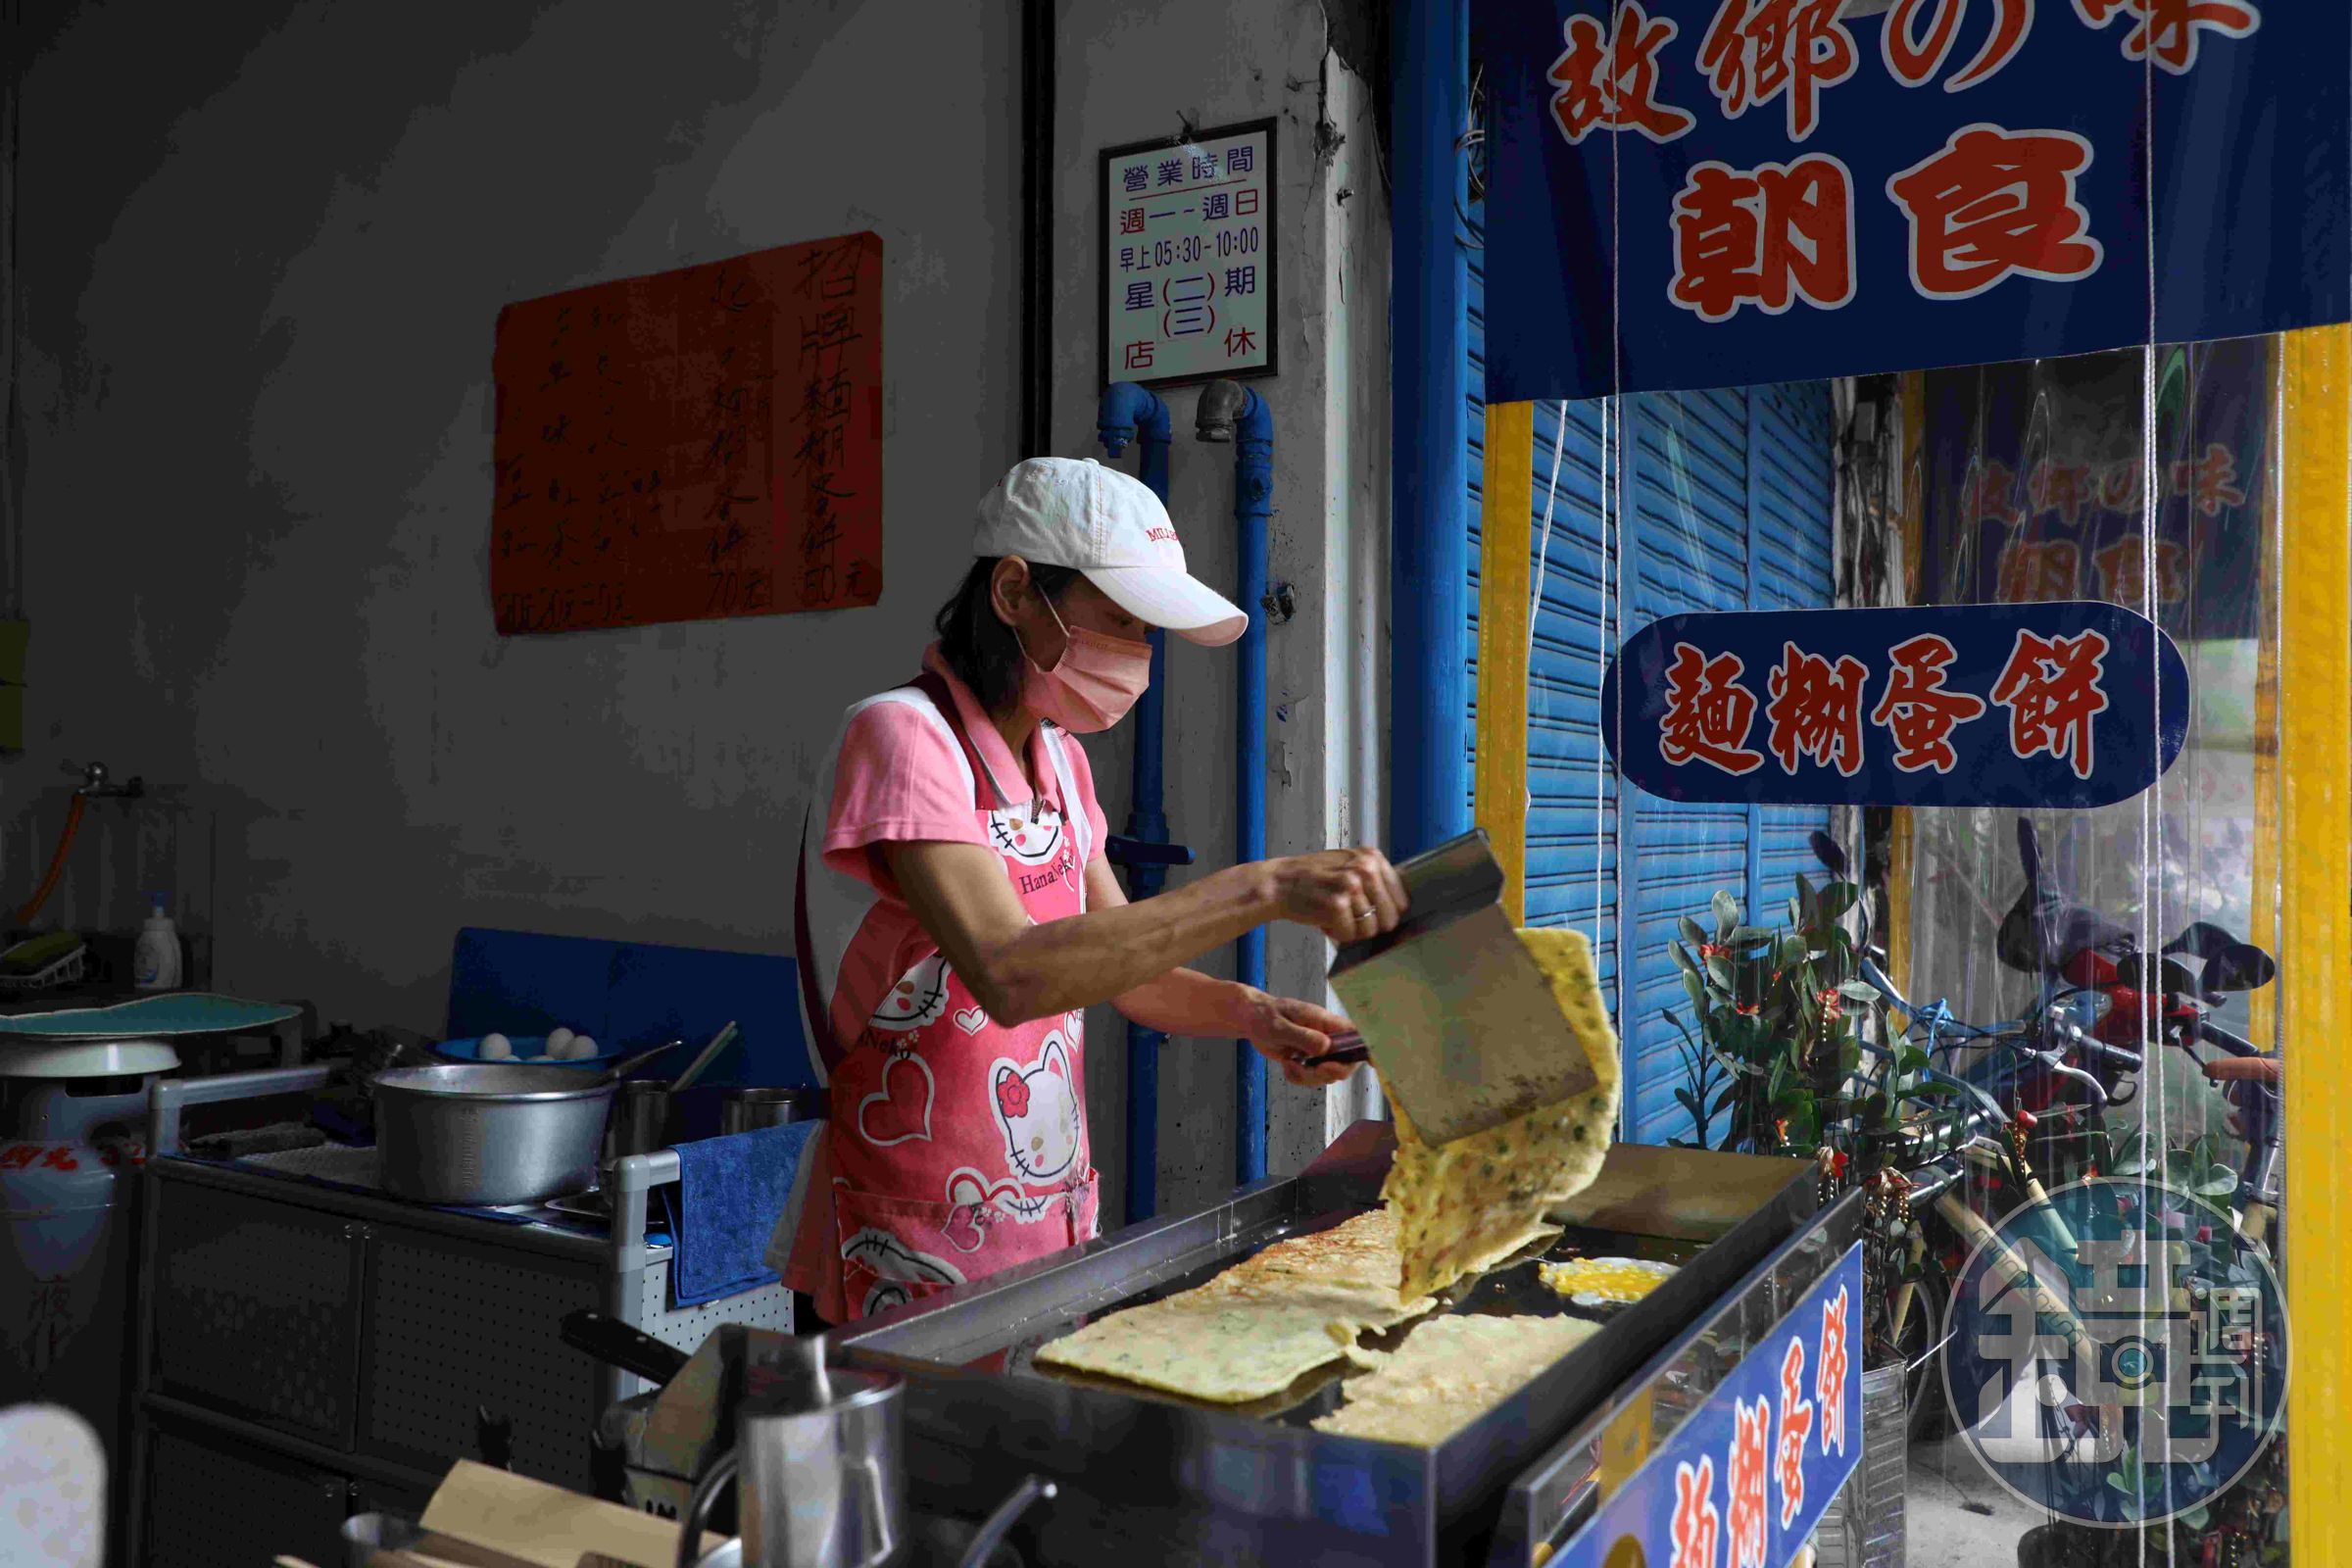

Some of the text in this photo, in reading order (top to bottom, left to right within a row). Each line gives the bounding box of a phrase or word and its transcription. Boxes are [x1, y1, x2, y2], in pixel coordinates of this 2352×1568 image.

[1123, 145, 1254, 193] 營業時間
[1668, 122, 2103, 322] 朝食
[1659, 628, 2109, 779] 麵糊蛋餅
